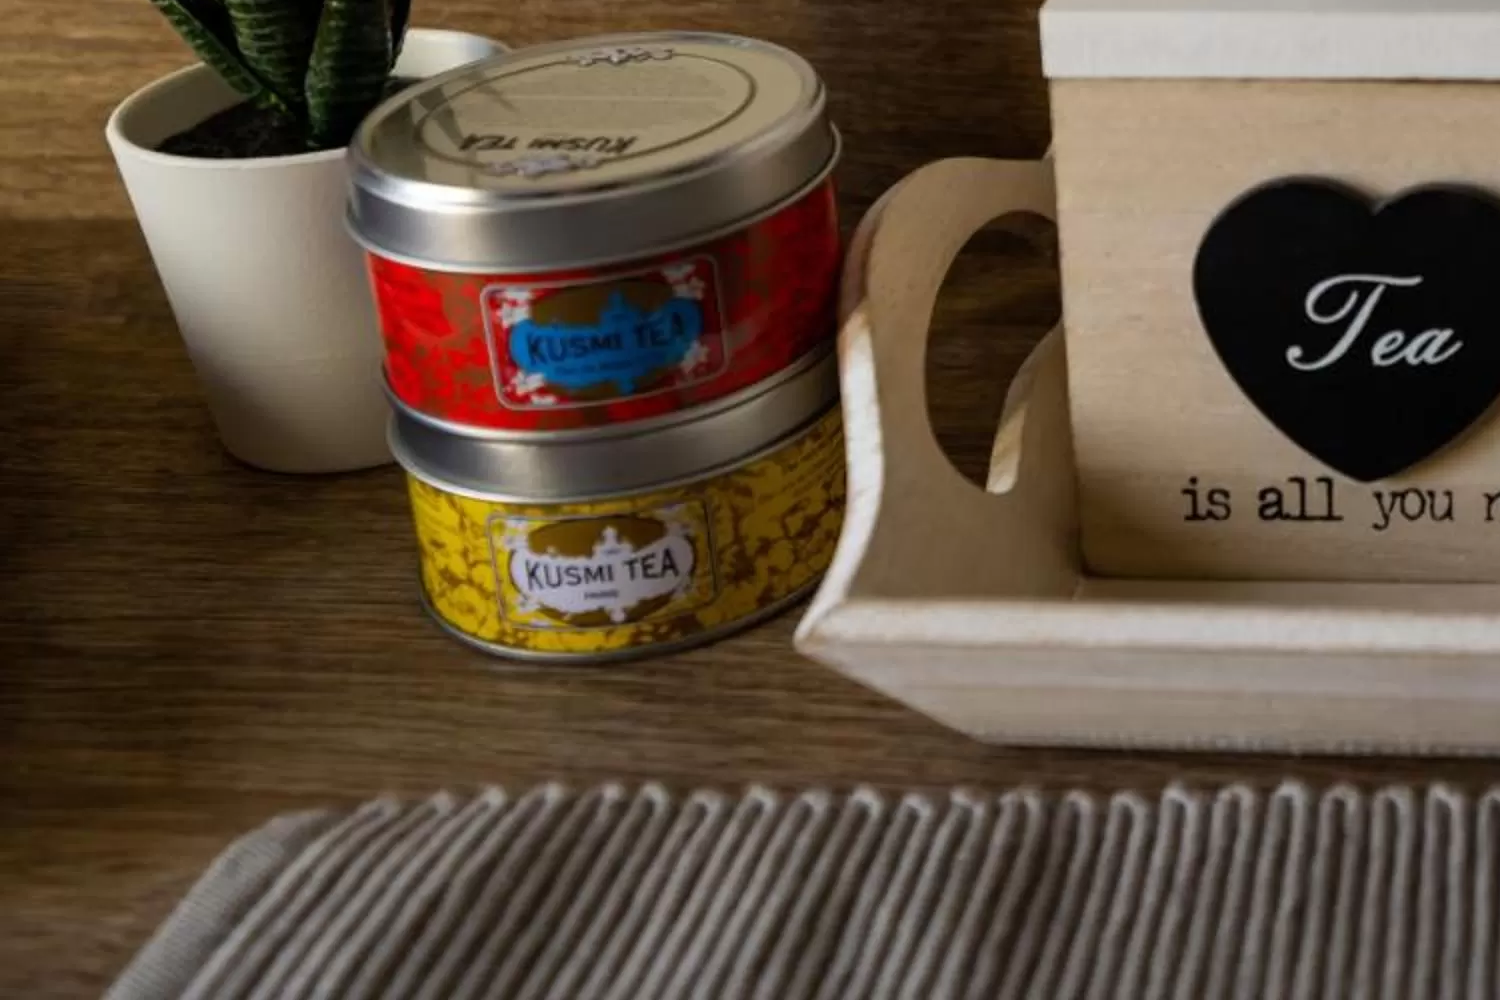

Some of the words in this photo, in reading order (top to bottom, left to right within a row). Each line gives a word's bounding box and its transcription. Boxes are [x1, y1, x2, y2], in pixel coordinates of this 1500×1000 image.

[458, 132, 519, 153] TEA
[528, 134, 638, 156] KUSMI
[526, 330, 624, 366] KUSMI
[632, 311, 687, 349] TEA
[1285, 273, 1464, 371] Tea
[1181, 477, 1232, 522] is
[1257, 477, 1344, 522] all
[1372, 486, 1455, 531] you
[524, 558, 615, 591] KUSMI
[623, 547, 680, 580] TEA
